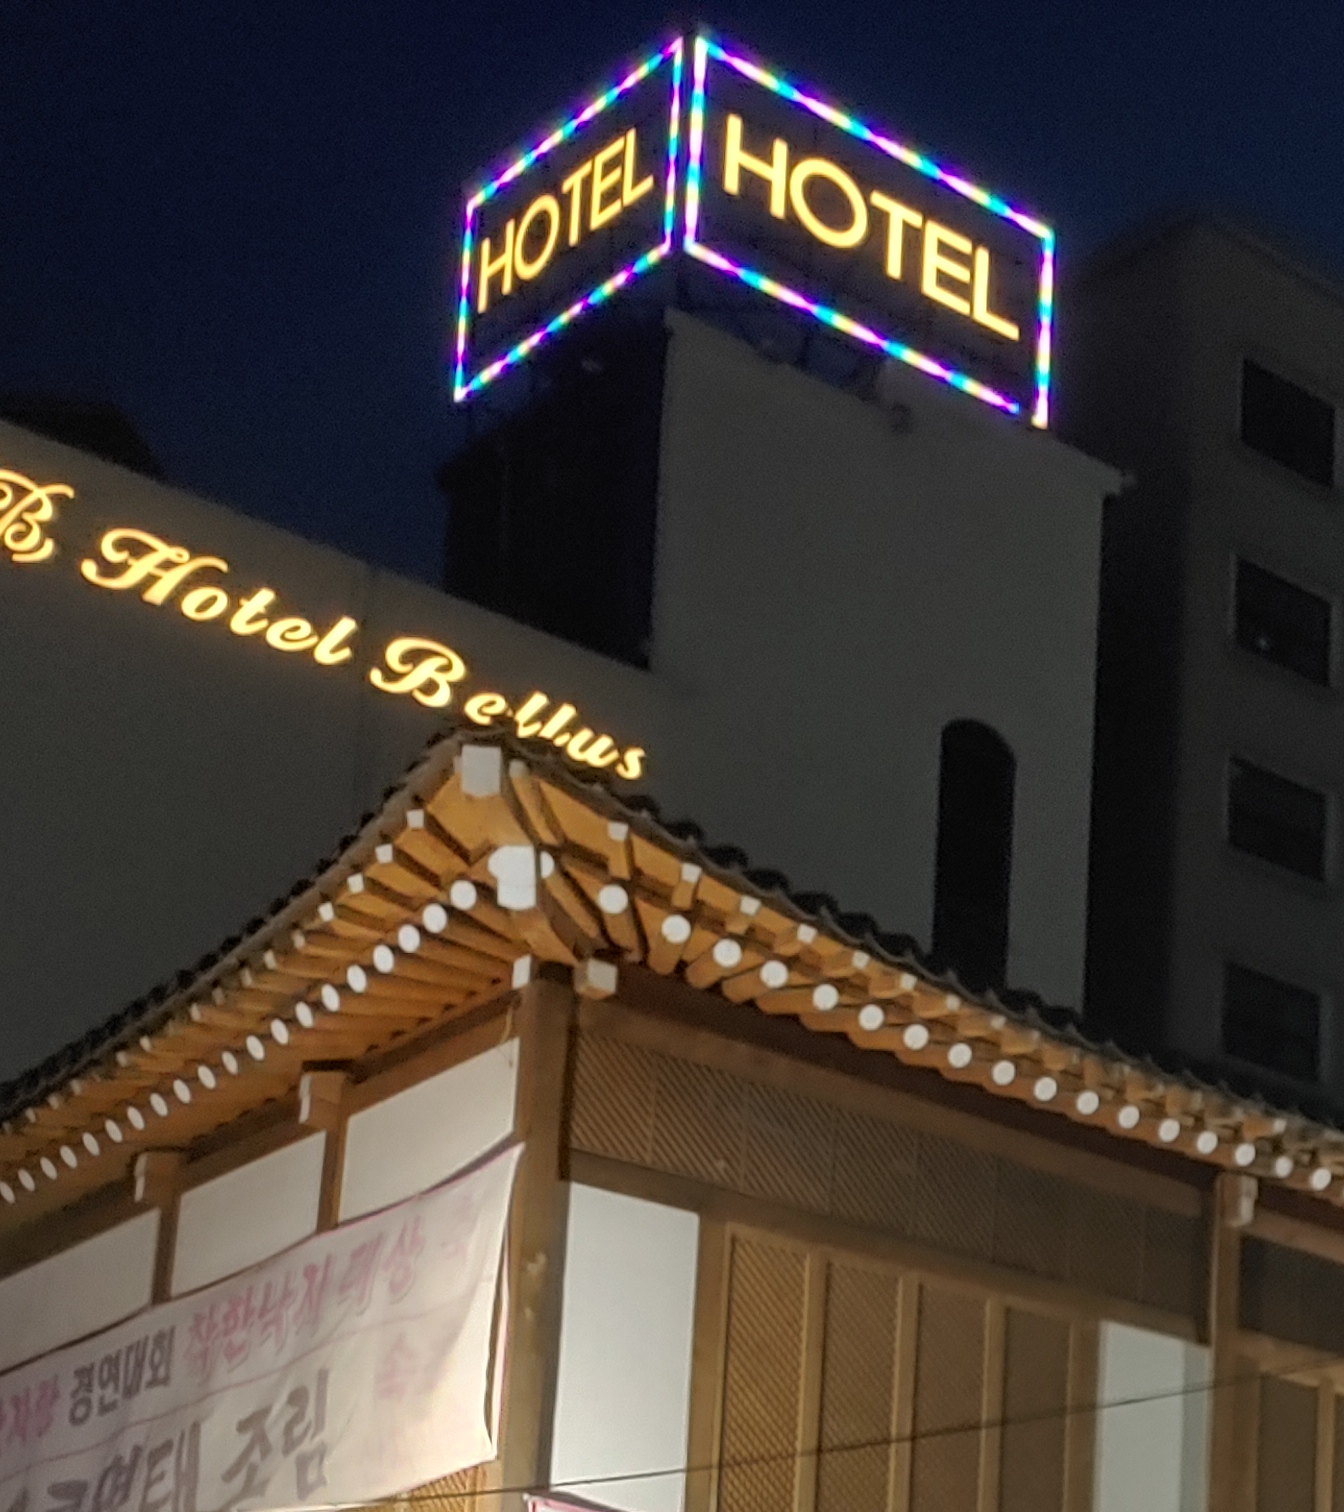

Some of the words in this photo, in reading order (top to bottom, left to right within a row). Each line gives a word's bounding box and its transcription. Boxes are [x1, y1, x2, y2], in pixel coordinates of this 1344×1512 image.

[475, 128, 656, 314] HOTEL
[722, 113, 1021, 342] HOTEL
[80, 527, 359, 666] Hotel
[369, 636, 647, 781] Bellus
[67, 1325, 177, 1428] 경연대회
[185, 1252, 333, 1387] 착한낙지
